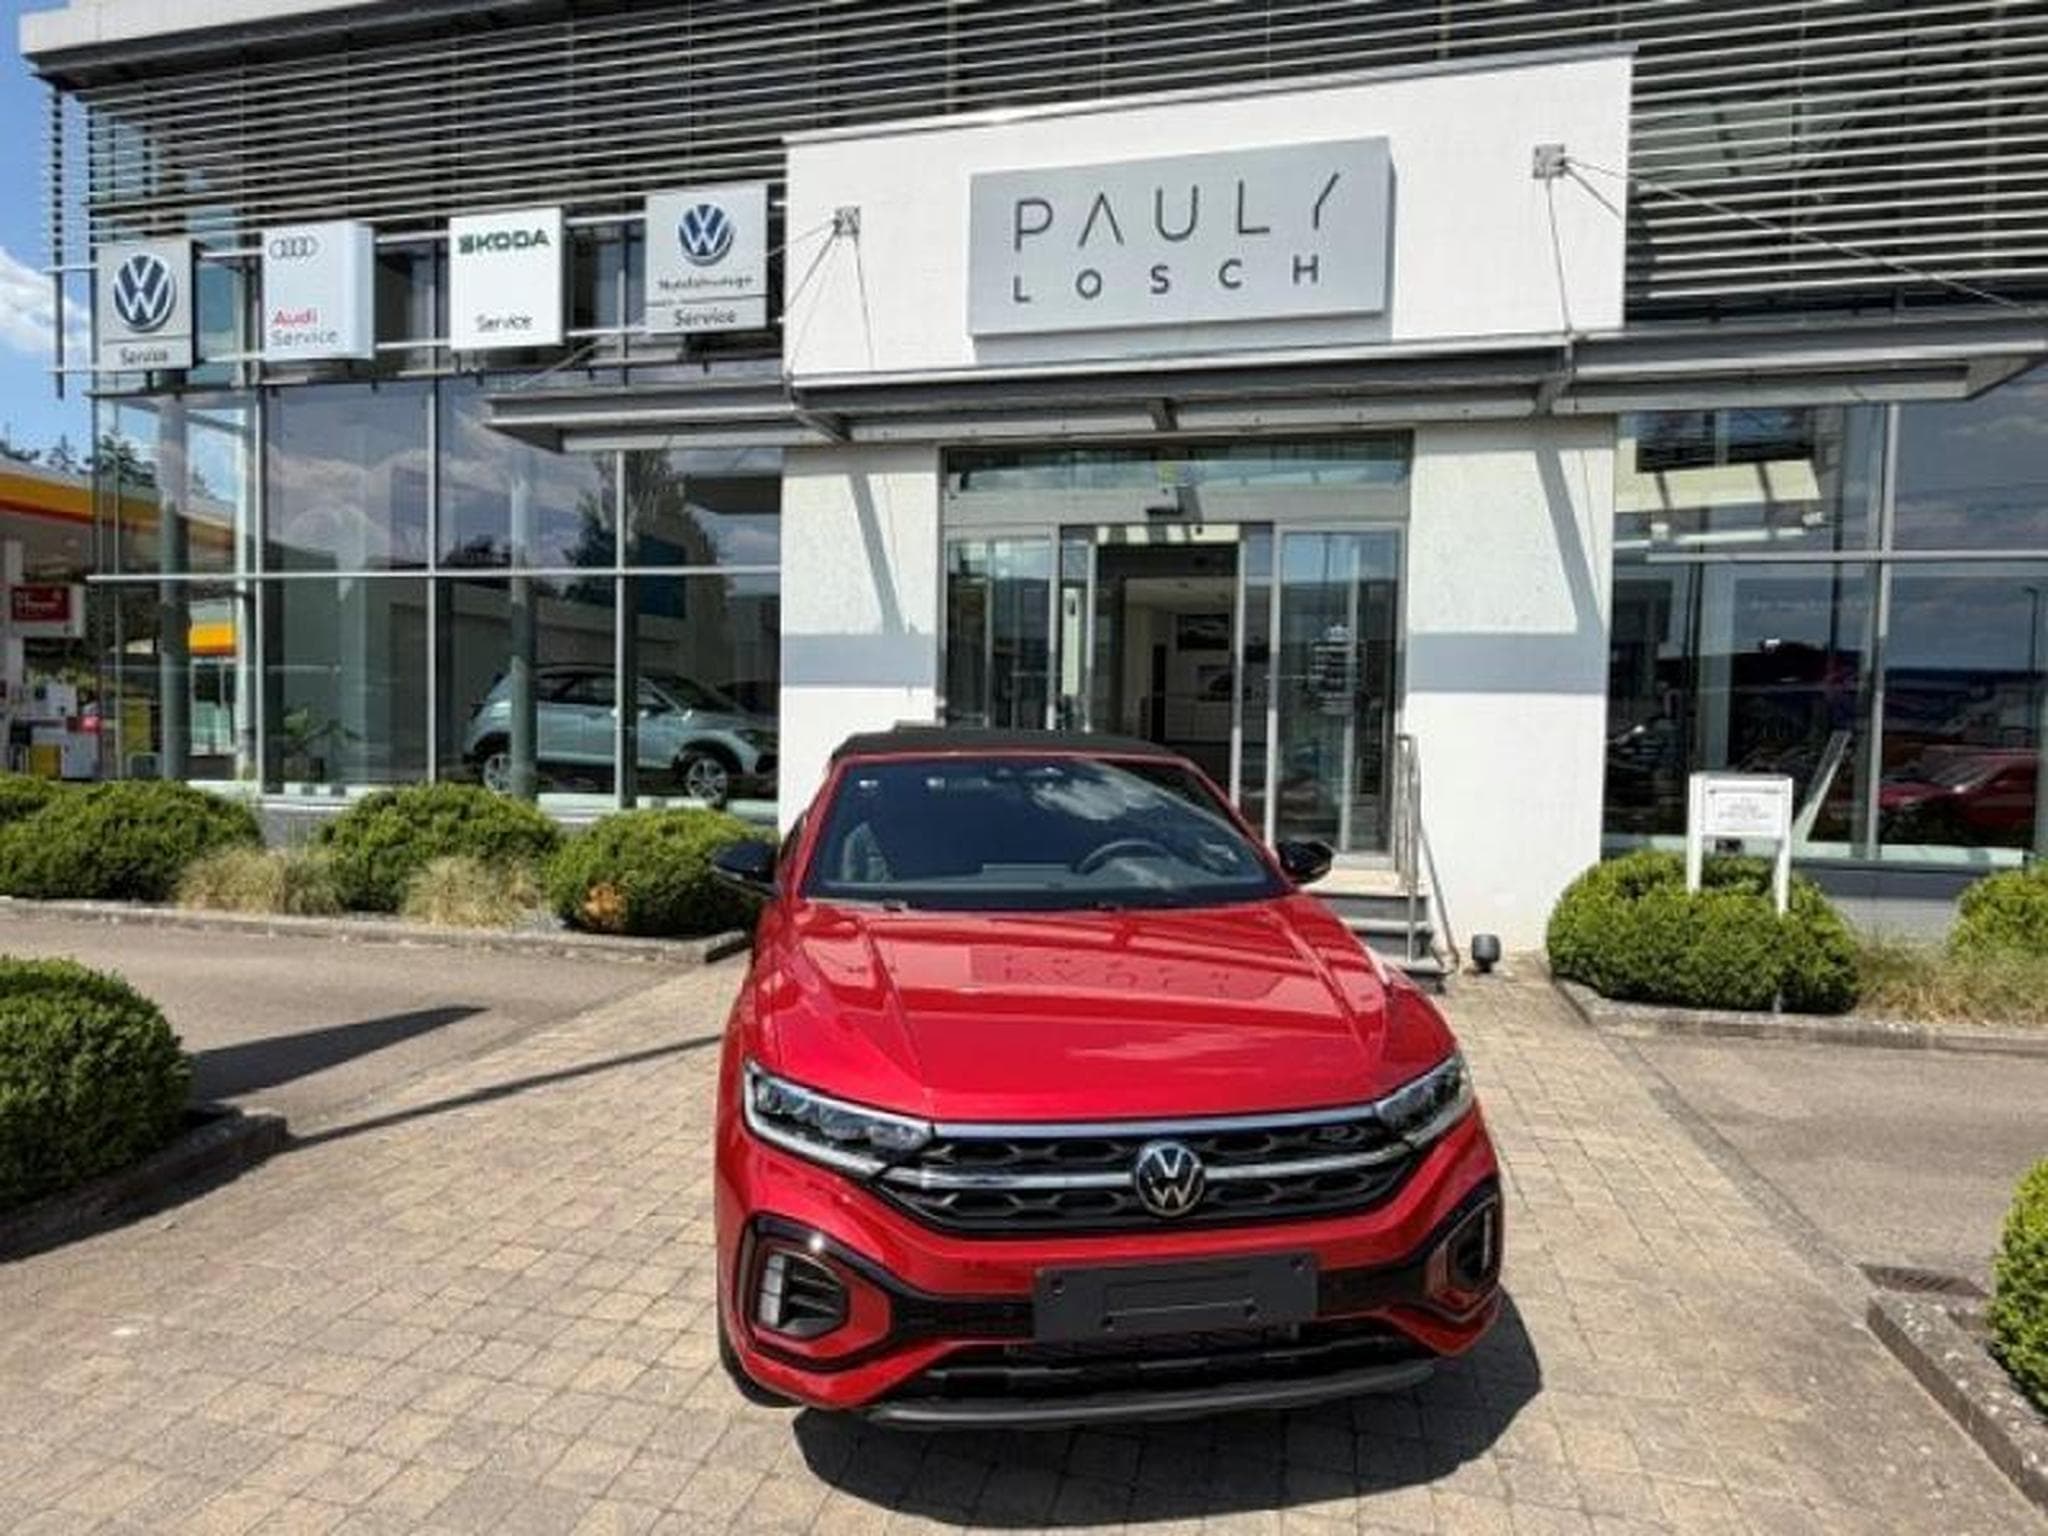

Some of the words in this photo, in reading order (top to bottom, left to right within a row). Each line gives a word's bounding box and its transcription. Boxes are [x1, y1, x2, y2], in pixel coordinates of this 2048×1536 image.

[1014, 172, 1340, 252] PAULY
[1013, 254, 1319, 302] LOSCH
[273, 308, 318, 324] Audi
[475, 313, 532, 332] Service
[674, 309, 736, 327] Service
[271, 330, 338, 346] Service
[120, 348, 168, 365] Service
